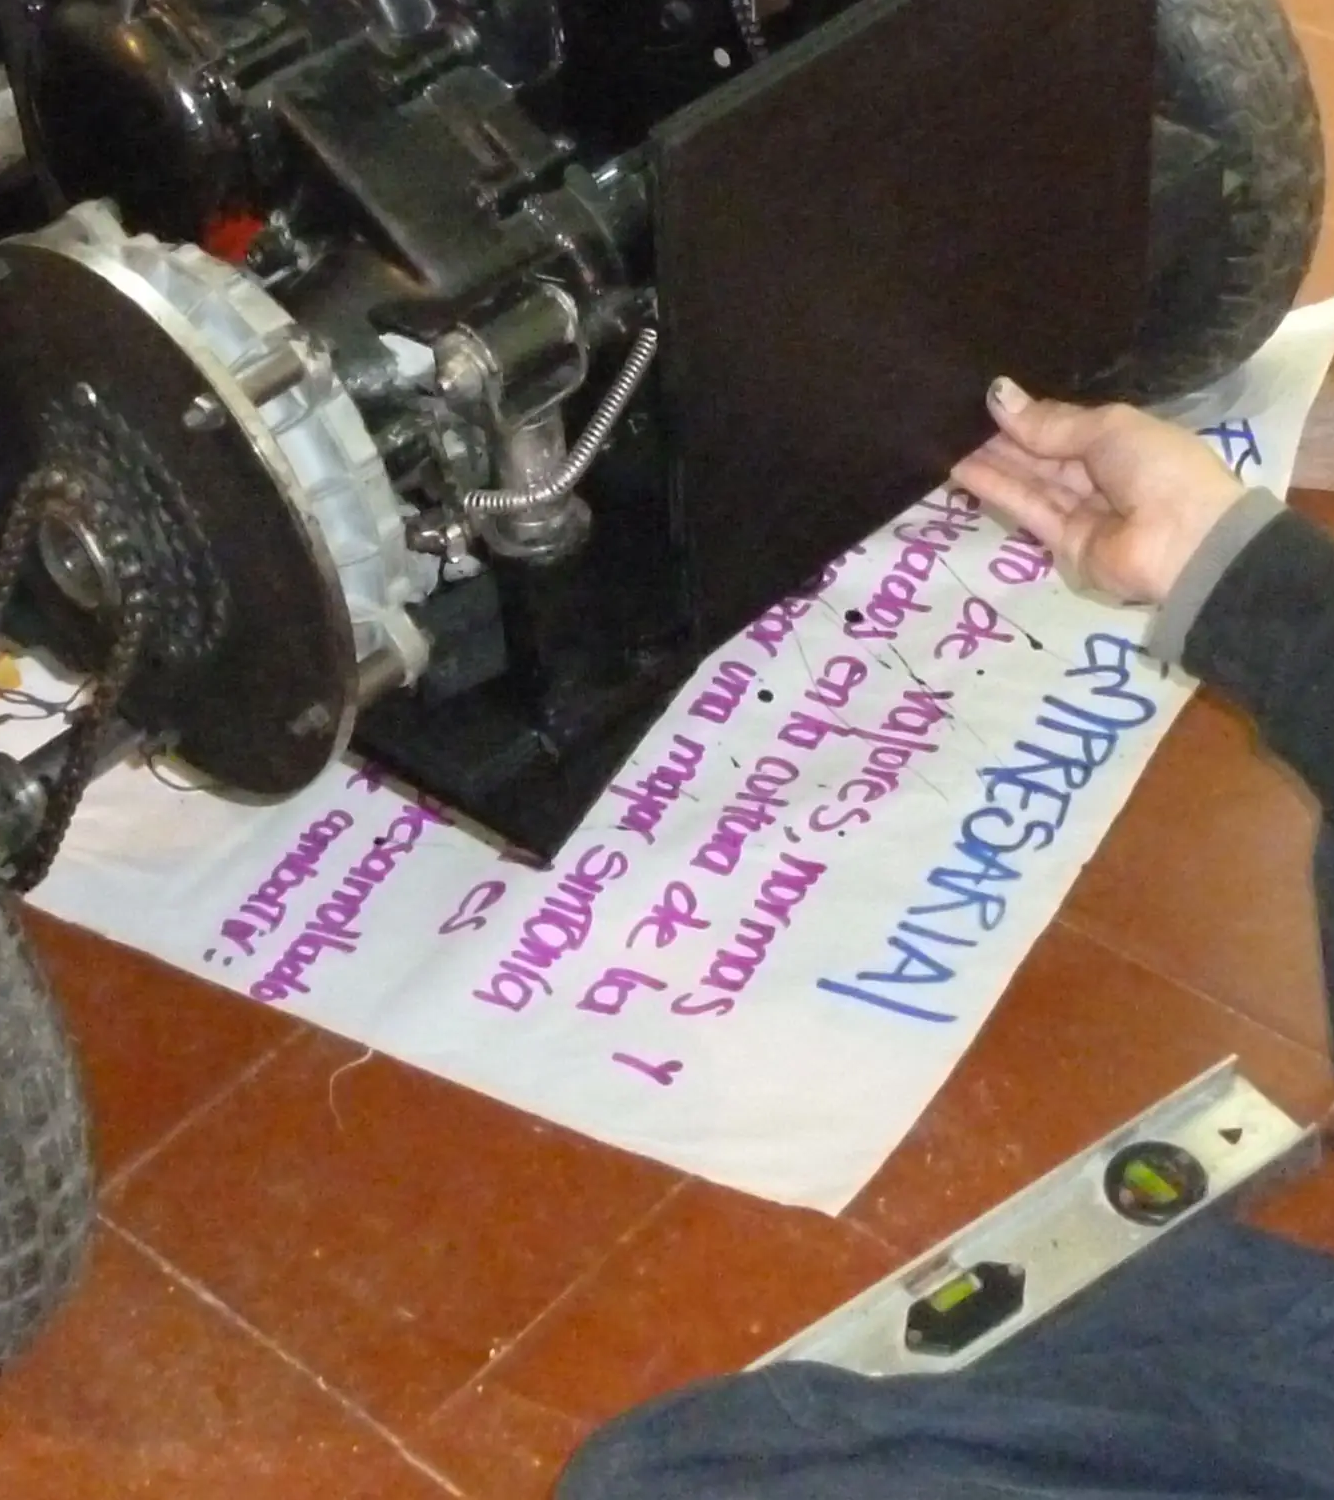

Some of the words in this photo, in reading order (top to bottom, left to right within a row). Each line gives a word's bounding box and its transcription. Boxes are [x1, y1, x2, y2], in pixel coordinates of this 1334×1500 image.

[845, 488, 982, 642] eflejados
[932, 599, 1010, 661] de
[690, 663, 755, 724] una
[804, 652, 869, 716] en
[776, 709, 857, 754] la
[612, 735, 707, 840] mayor
[690, 754, 799, 877] cultura
[440, 878, 508, 934] es
[624, 879, 710, 948] de
[670, 852, 827, 1017] normas
[574, 965, 668, 1018] la
